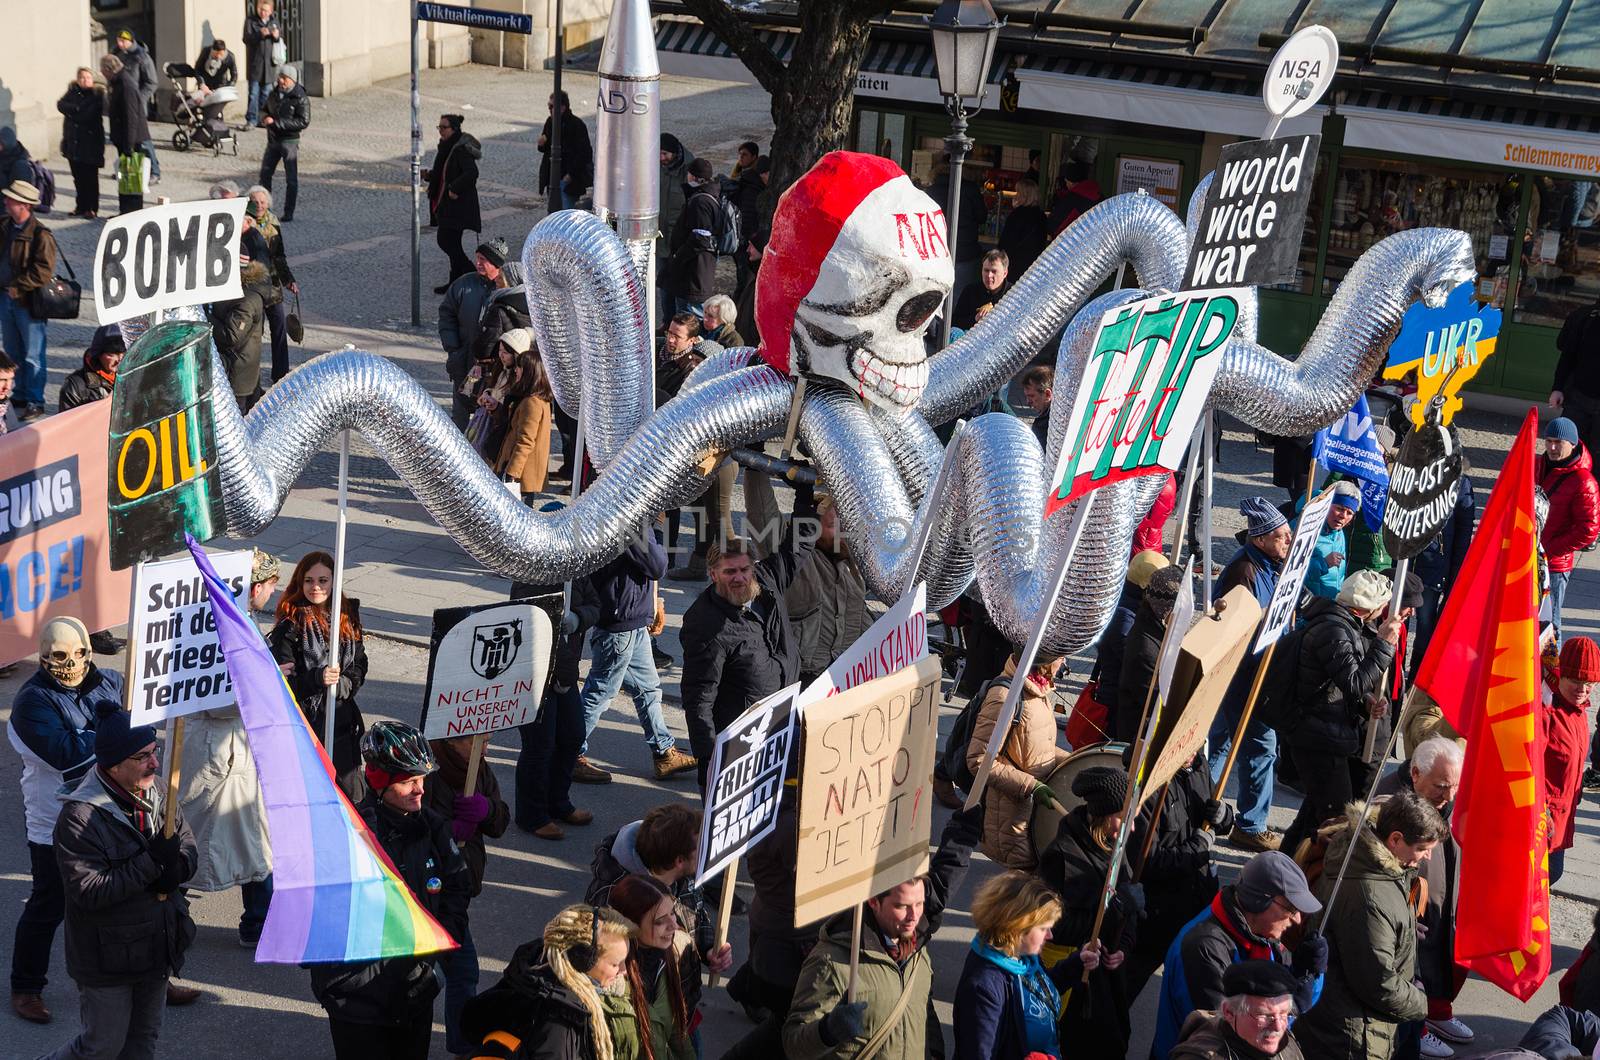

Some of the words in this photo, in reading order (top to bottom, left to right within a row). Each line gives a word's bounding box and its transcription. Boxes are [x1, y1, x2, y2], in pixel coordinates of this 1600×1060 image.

[425, 4, 522, 28] Viktualienmarkt
[1279, 60, 1321, 78] NSA
[1283, 84, 1299, 95] BN
[1124, 162, 1145, 173] Guten
[1146, 164, 1174, 176] Appetit!
[1219, 135, 1310, 199] world
[1205, 194, 1277, 244] wide
[102, 212, 235, 309] BOMB
[1191, 245, 1257, 287] war
[1423, 318, 1483, 378] UKR
[1057, 295, 1239, 499] TTIP
[118, 411, 207, 499] OIL
[1390, 457, 1450, 495] NATO-OST-
[1384, 480, 1458, 539] ERWEITERUNG
[148, 575, 243, 612] Schlus
[146, 612, 183, 644] mit
[190, 607, 217, 636] de
[144, 642, 225, 679] Kriegs
[144, 671, 232, 711] Terror!
[438, 684, 504, 707] NICHT
[514, 679, 533, 694] IN
[456, 698, 519, 718] UNSEREM
[820, 680, 937, 774] STOPPT
[713, 731, 789, 807] FRIEDEN
[824, 746, 910, 820] NATO
[710, 797, 773, 860] NATO!
[712, 774, 777, 837] STATT
[816, 786, 924, 873] JETZT!
